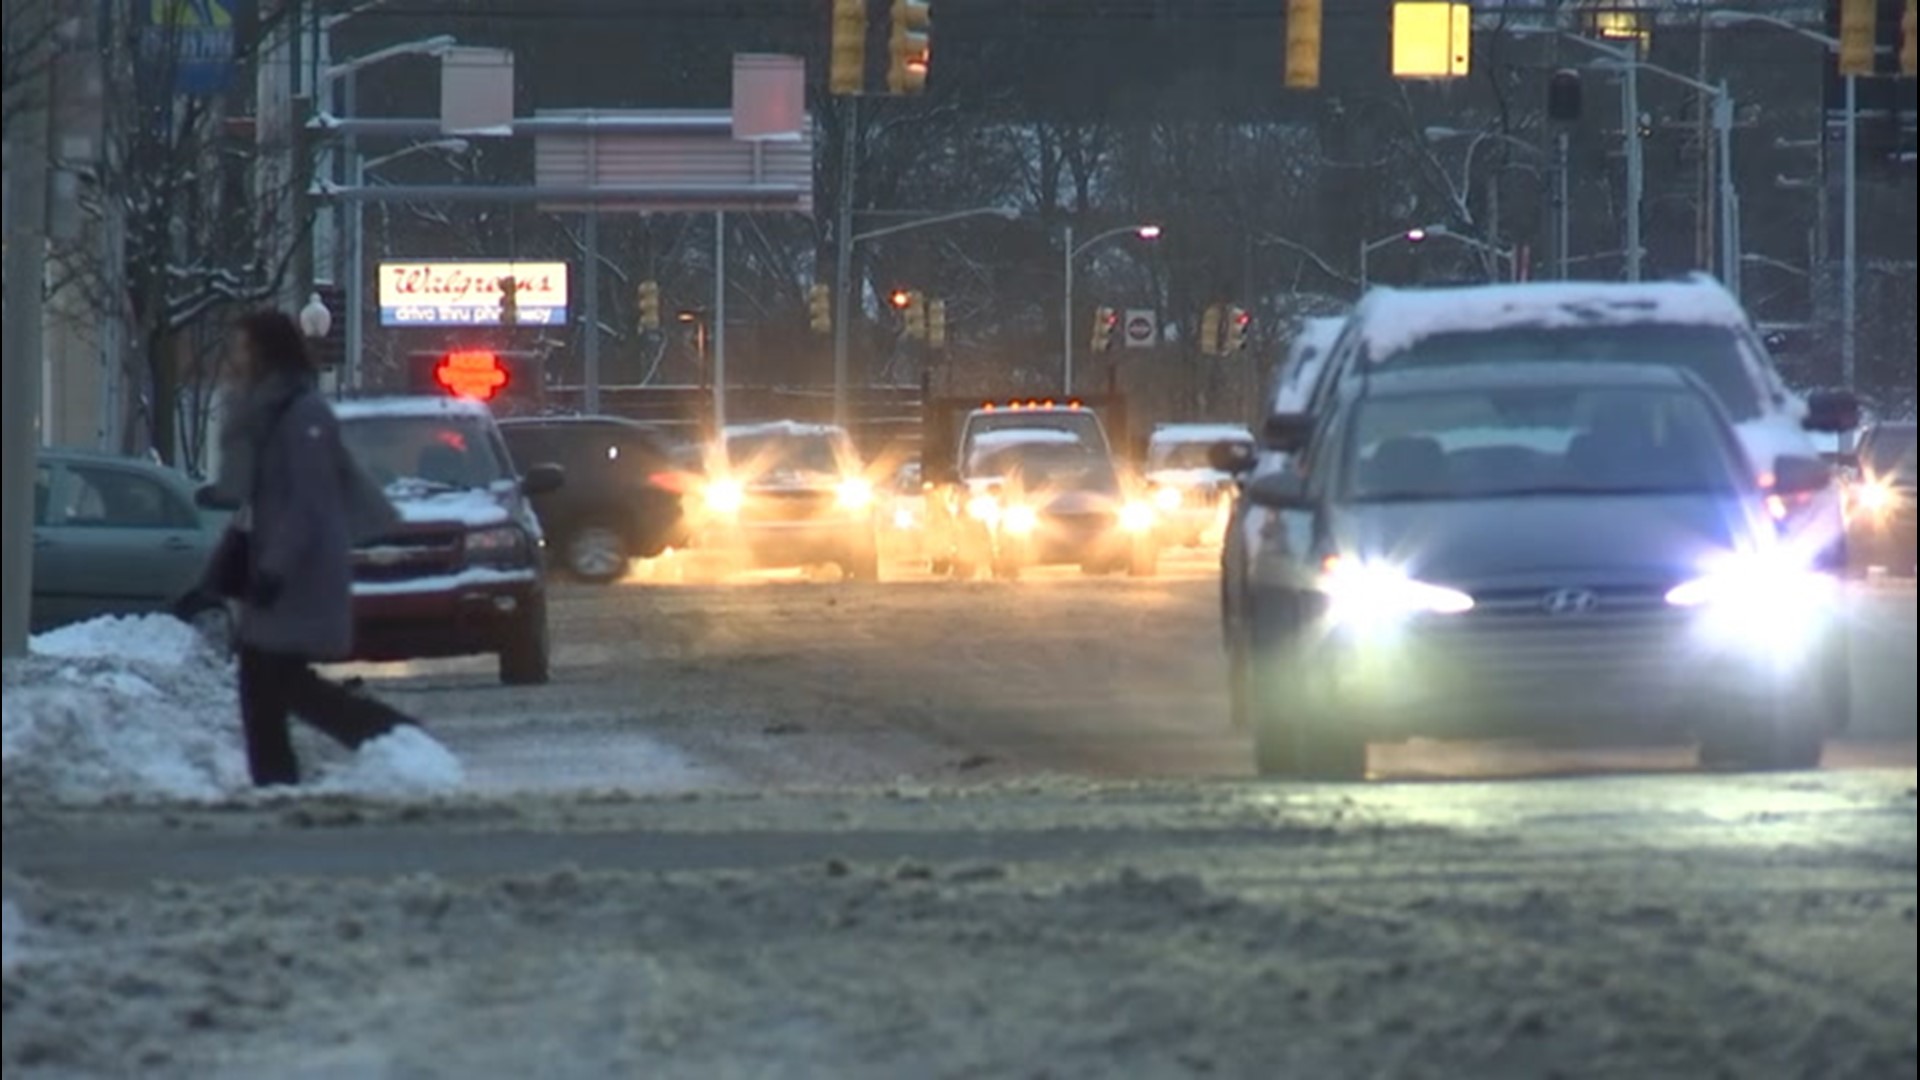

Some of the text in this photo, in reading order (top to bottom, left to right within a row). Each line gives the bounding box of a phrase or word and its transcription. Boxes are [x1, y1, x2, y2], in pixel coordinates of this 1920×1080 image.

[393, 267, 552, 303] Walgrens
[395, 306, 552, 324] drive thru phaacy
